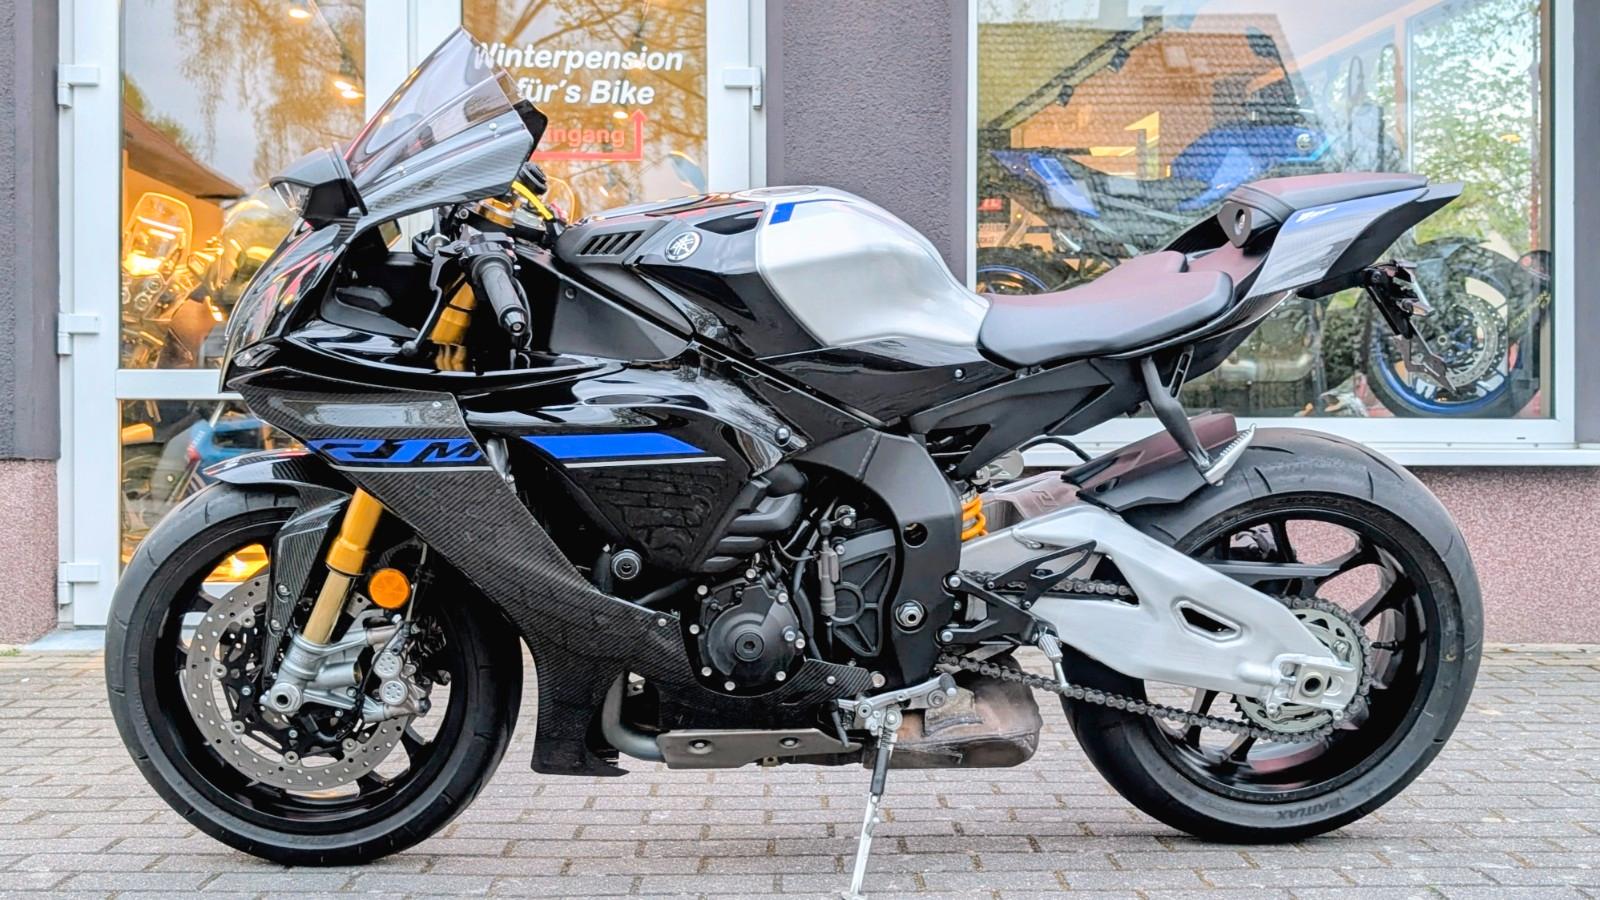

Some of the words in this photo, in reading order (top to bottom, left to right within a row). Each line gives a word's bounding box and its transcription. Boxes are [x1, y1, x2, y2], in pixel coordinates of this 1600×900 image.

[474, 42, 683, 74] Winterpension
[590, 79, 655, 105] Bike
[546, 124, 625, 148] ingang
[307, 438, 482, 463] R1M
